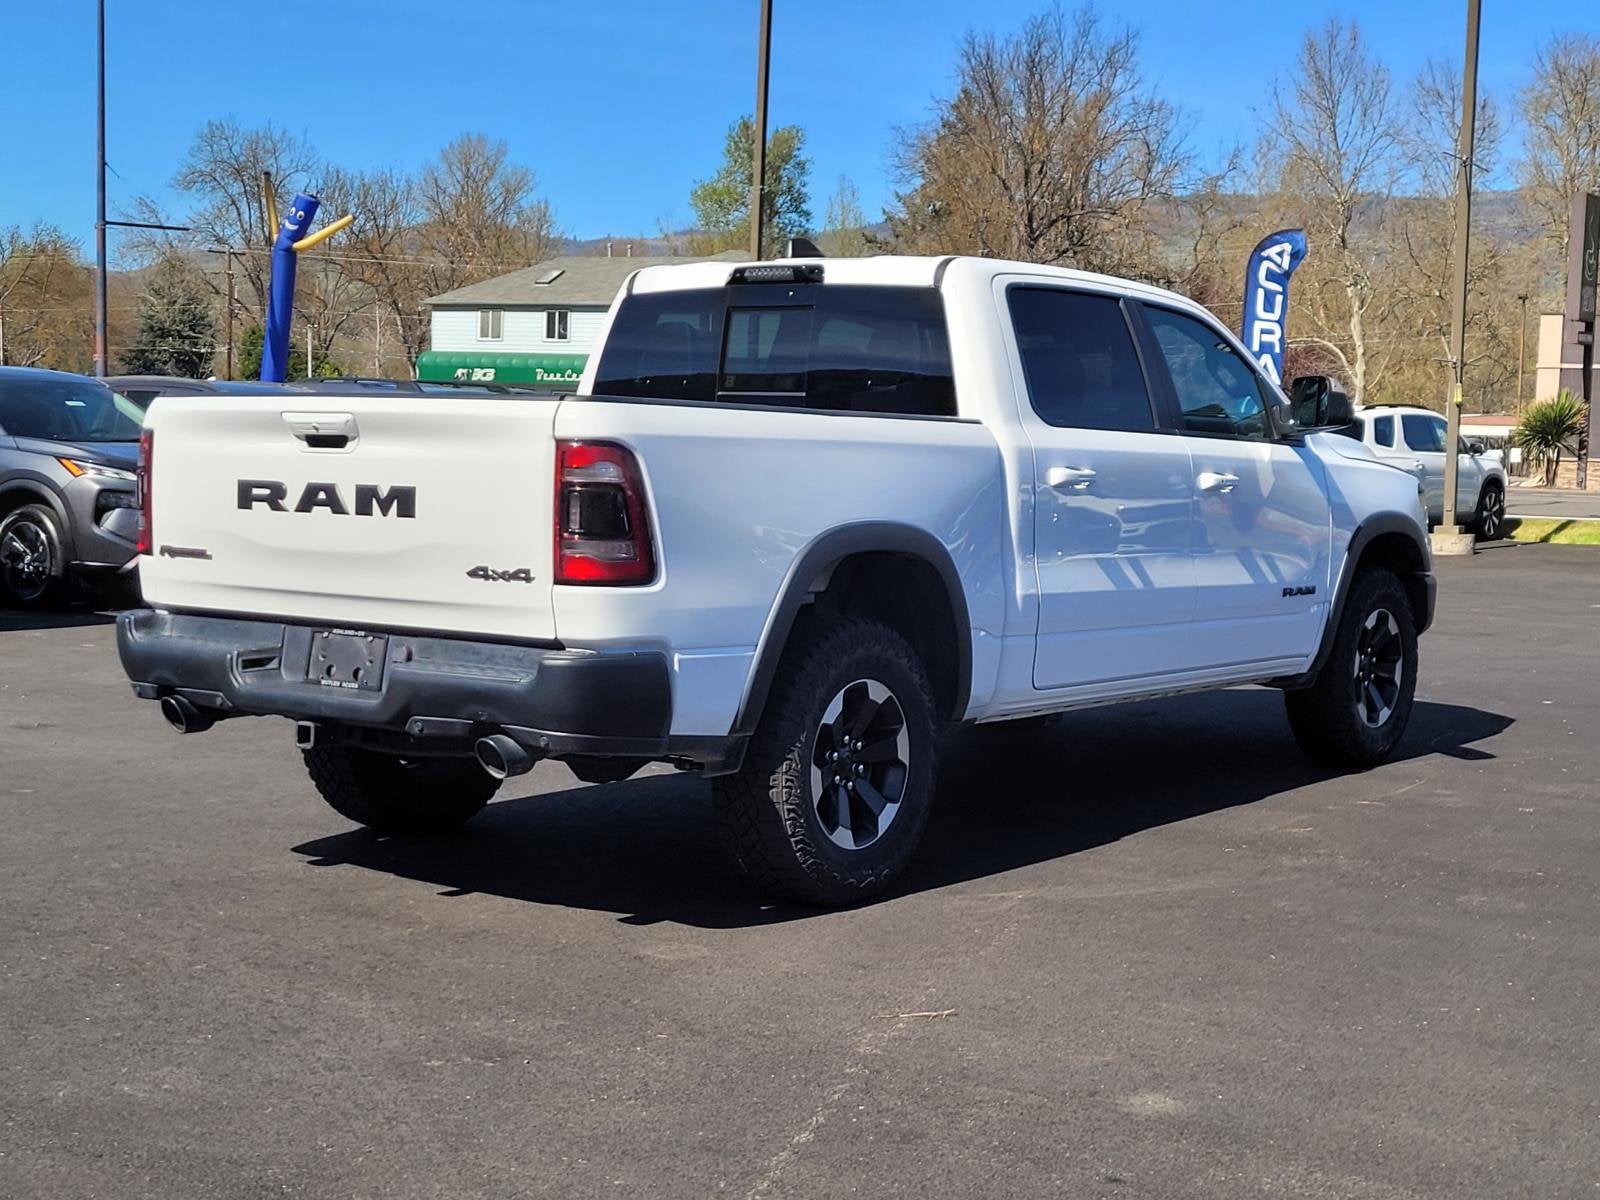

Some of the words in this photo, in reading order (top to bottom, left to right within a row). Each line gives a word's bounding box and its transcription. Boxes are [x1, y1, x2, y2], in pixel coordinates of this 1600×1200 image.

[1252, 242, 1292, 386] ACURA
[237, 479, 416, 518] RAM
[1282, 585, 1316, 597] RAM
